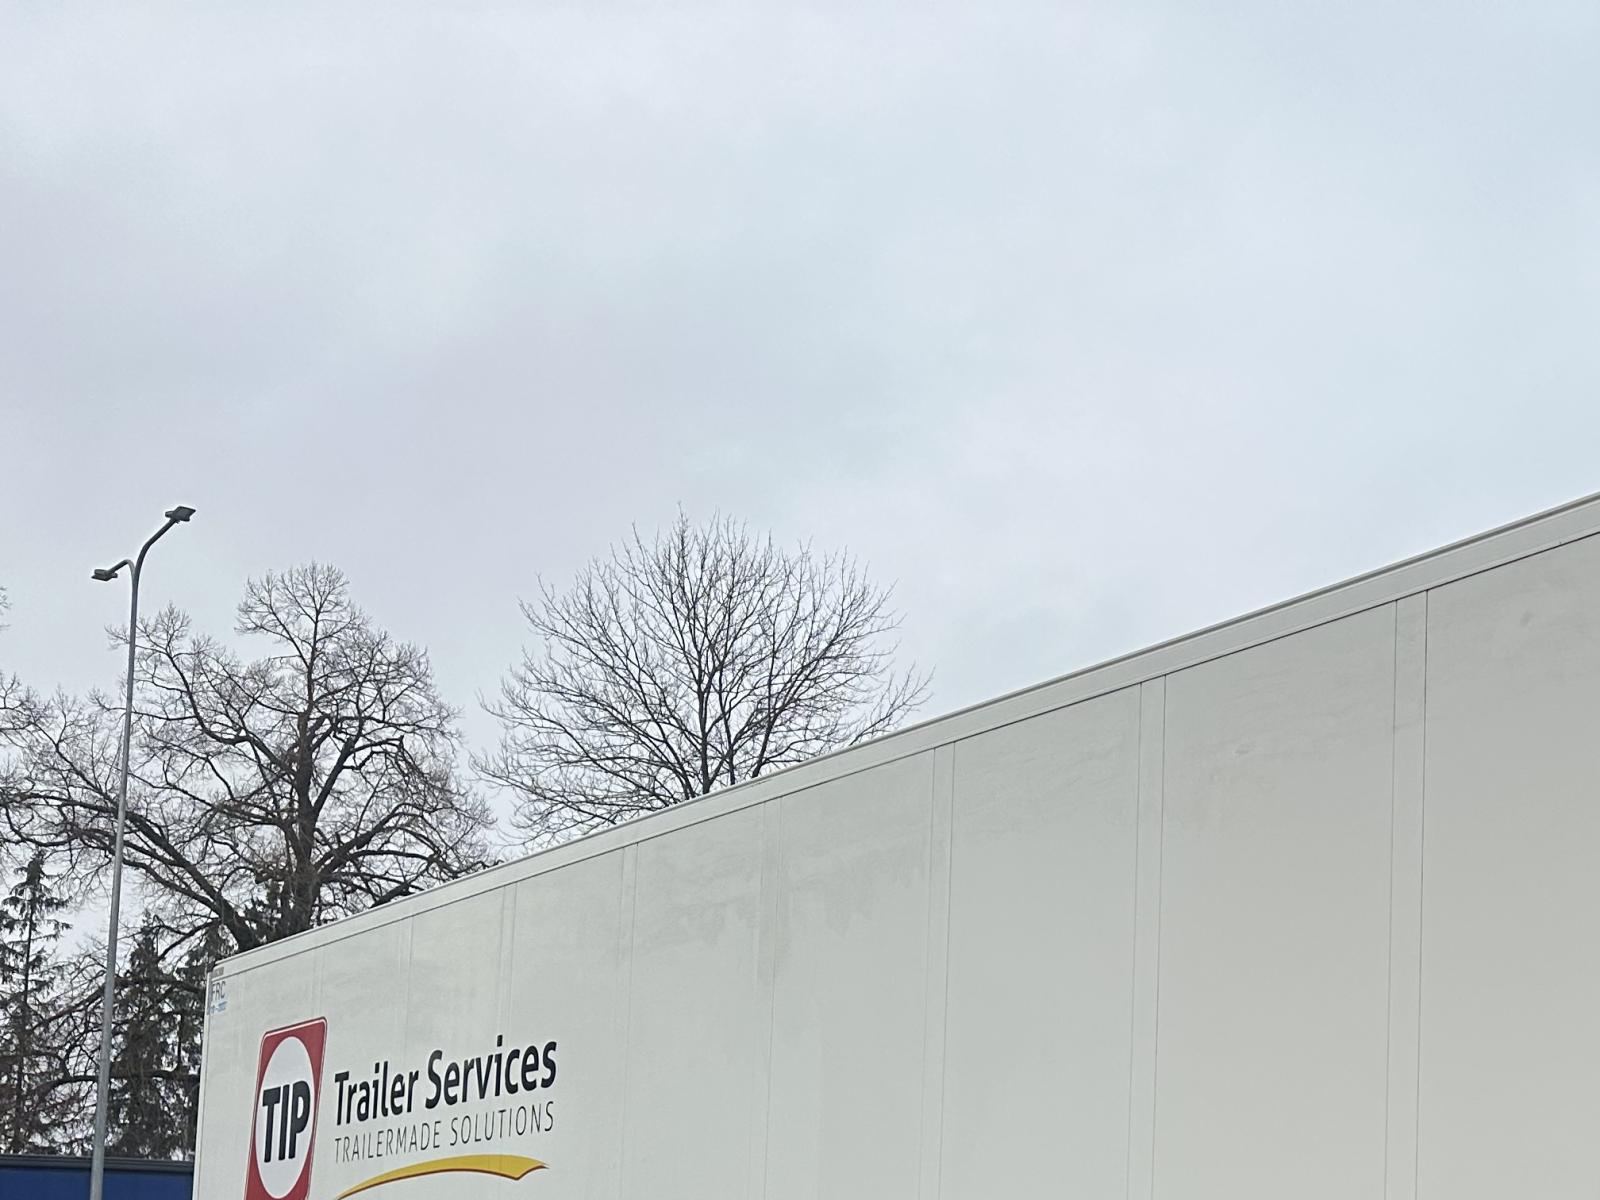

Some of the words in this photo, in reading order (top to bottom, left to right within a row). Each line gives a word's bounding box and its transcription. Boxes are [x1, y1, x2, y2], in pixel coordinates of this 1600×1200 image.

[262, 1080, 311, 1163] TIP
[334, 1061, 419, 1126] Trailer
[425, 1034, 558, 1109] Services
[334, 1120, 442, 1164] TRAILERMADE
[449, 1101, 555, 1147] SOLUTIONS
